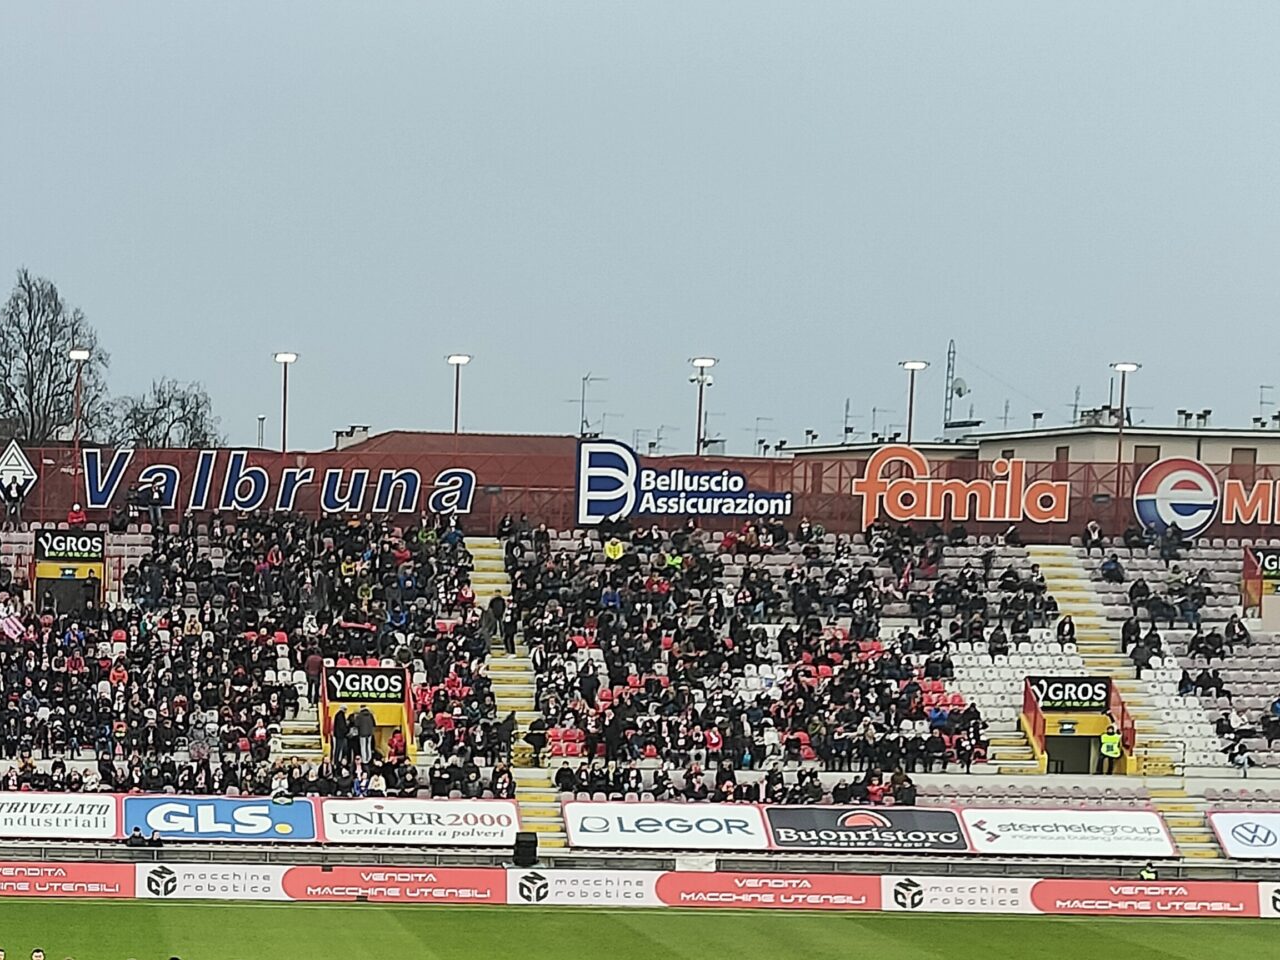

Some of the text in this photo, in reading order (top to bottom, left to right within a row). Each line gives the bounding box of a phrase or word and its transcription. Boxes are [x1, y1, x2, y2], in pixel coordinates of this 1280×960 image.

[82, 448, 477, 514] Valbruna
[640, 470, 744, 493] Belluscio
[852, 445, 1070, 531] famila
[639, 493, 792, 516] Assicurazioni
[330, 807, 513, 828] UNIVER2000
[339, 826, 434, 838] verniciatura
[451, 828, 505, 841] polveri
[997, 821, 1161, 836] sterchelegroup
[775, 827, 959, 844] Buonristoro
[182, 871, 271, 881] macchine
[360, 872, 438, 882] VENDITA
[554, 876, 645, 887] macchine
[35, 882, 120, 893] UTENSILI
[182, 883, 271, 893] robotica
[733, 878, 812, 889] VENDITA
[929, 884, 1020, 895] macchine
[306, 886, 491, 898] MACCHINE UTENSILI
[554, 888, 645, 899] robotica
[1109, 885, 1189, 896] VENDITA
[680, 891, 867, 905] MACCHINE UTENSILI
[929, 896, 1020, 907] robotica
[1056, 899, 1244, 912] MACCHINE UTENSILI
